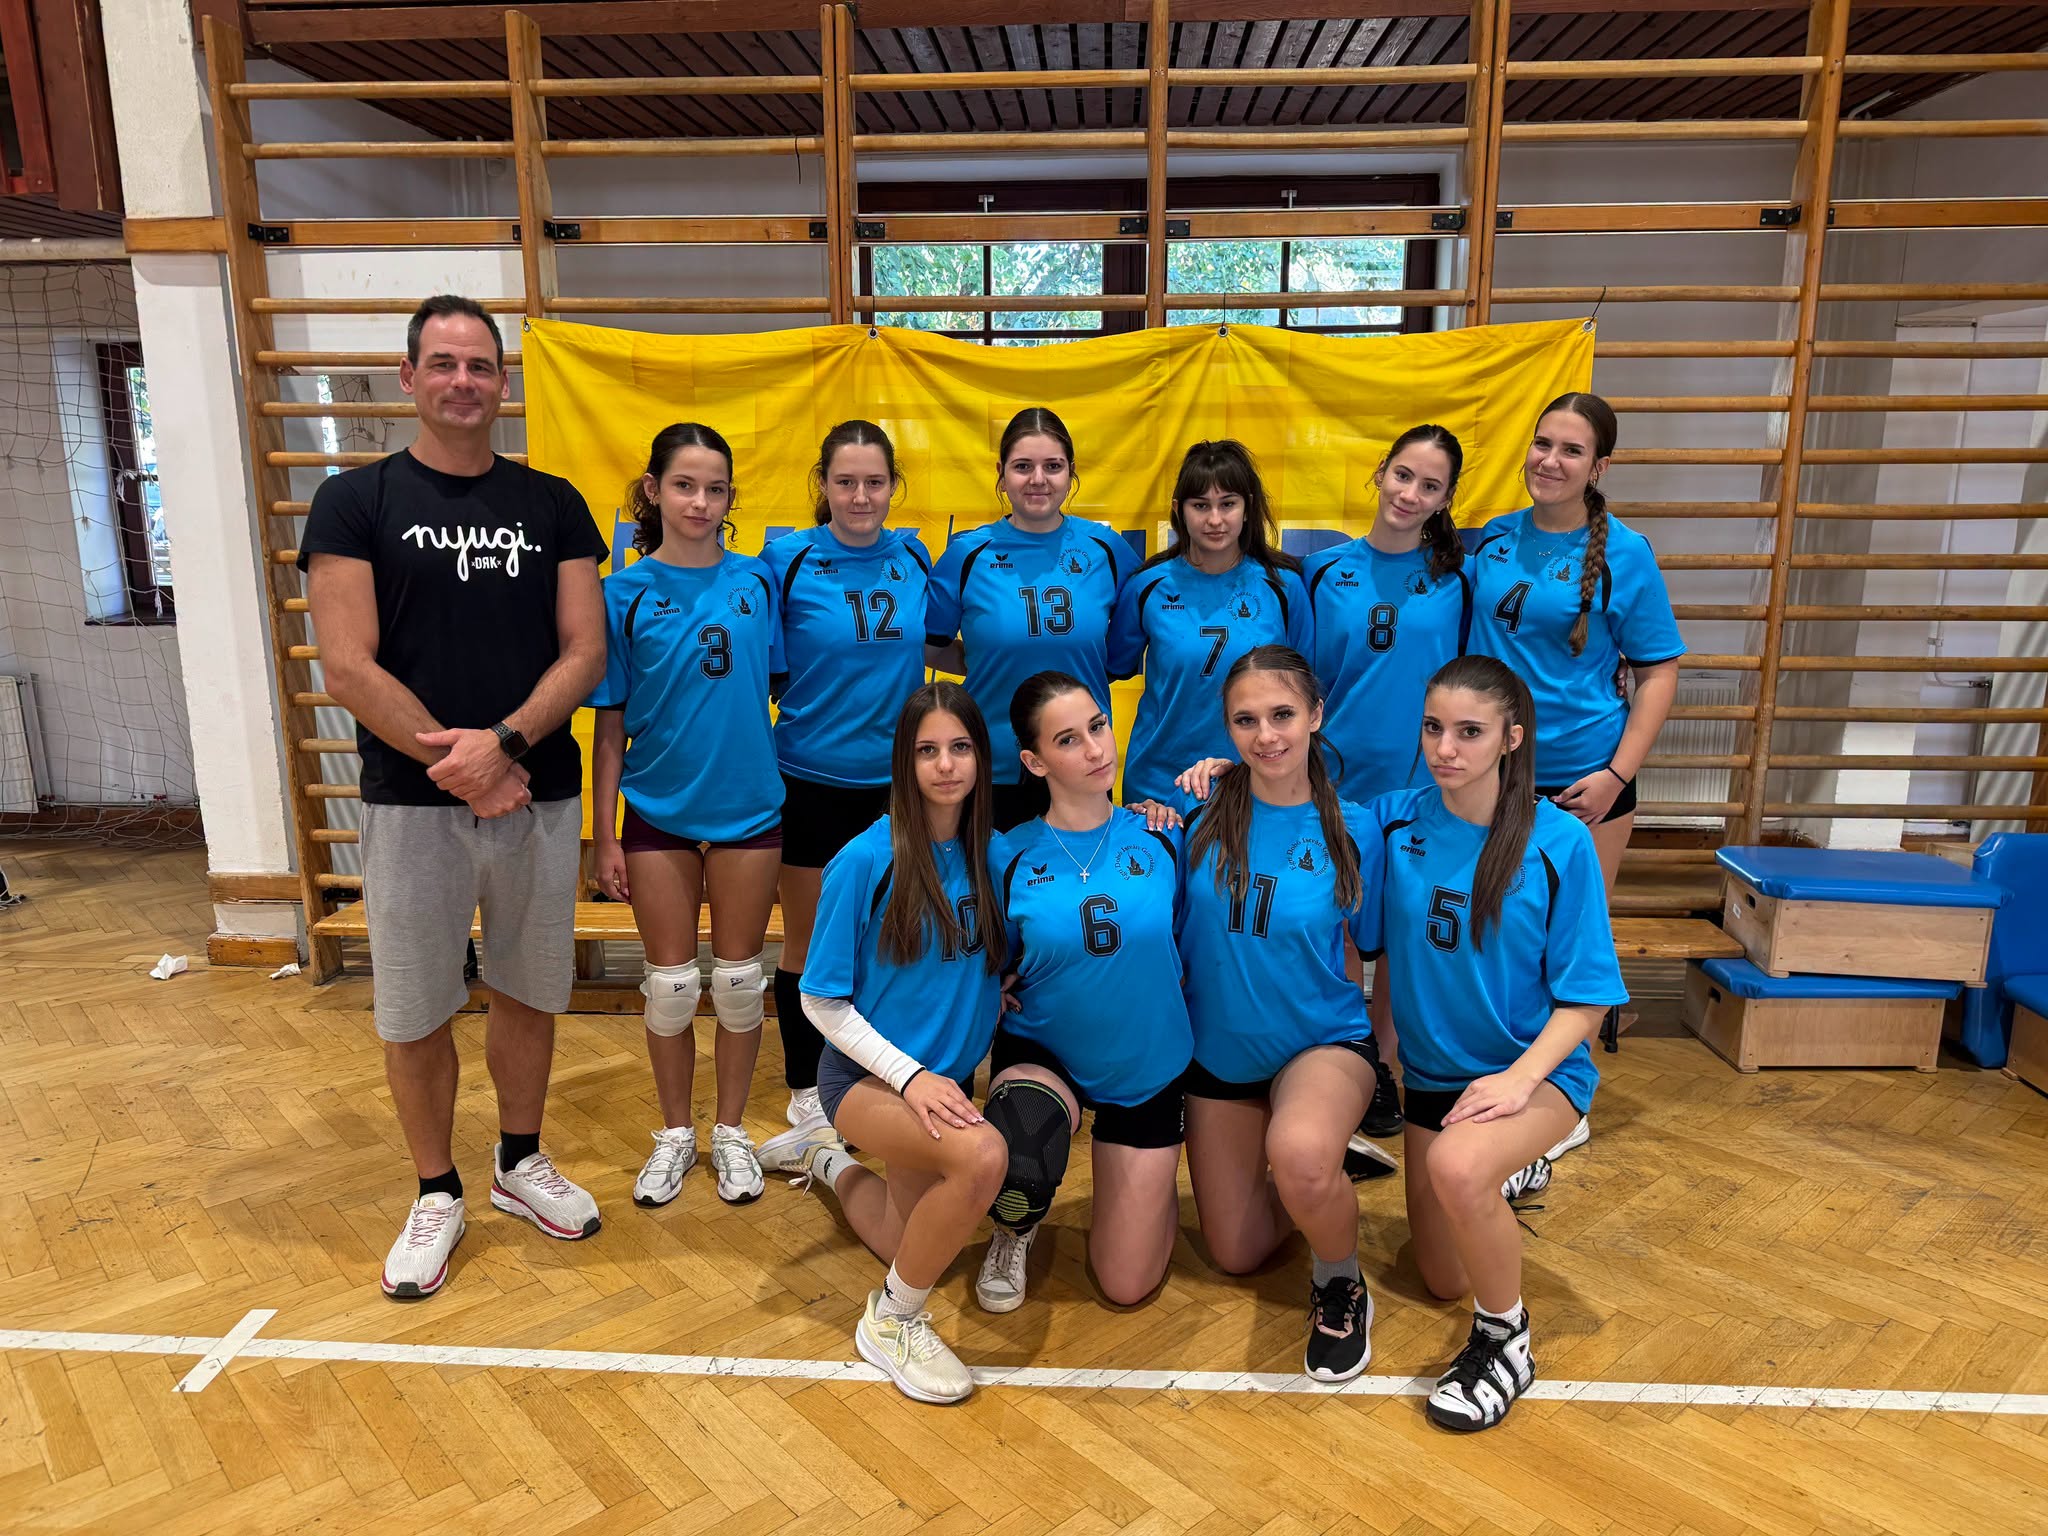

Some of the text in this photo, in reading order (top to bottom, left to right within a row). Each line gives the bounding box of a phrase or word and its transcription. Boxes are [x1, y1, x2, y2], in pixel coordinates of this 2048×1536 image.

[402, 522, 541, 582] nyugi.
[814, 568, 838, 576] erima
[1487, 553, 1508, 564] erima
[653, 607, 680, 617] erima
[844, 589, 903, 642] 12
[1018, 586, 1074, 637] 13
[1367, 602, 1398, 653] 8
[1493, 580, 1534, 634] 4
[698, 624, 733, 679] 3
[1200, 626, 1229, 676] 7
[1400, 844, 1426, 857] erima
[1027, 875, 1055, 887] erima
[1227, 870, 1278, 938] 11
[941, 893, 984, 961] 0
[1079, 894, 1122, 957] 6
[1426, 885, 1470, 953] 5
